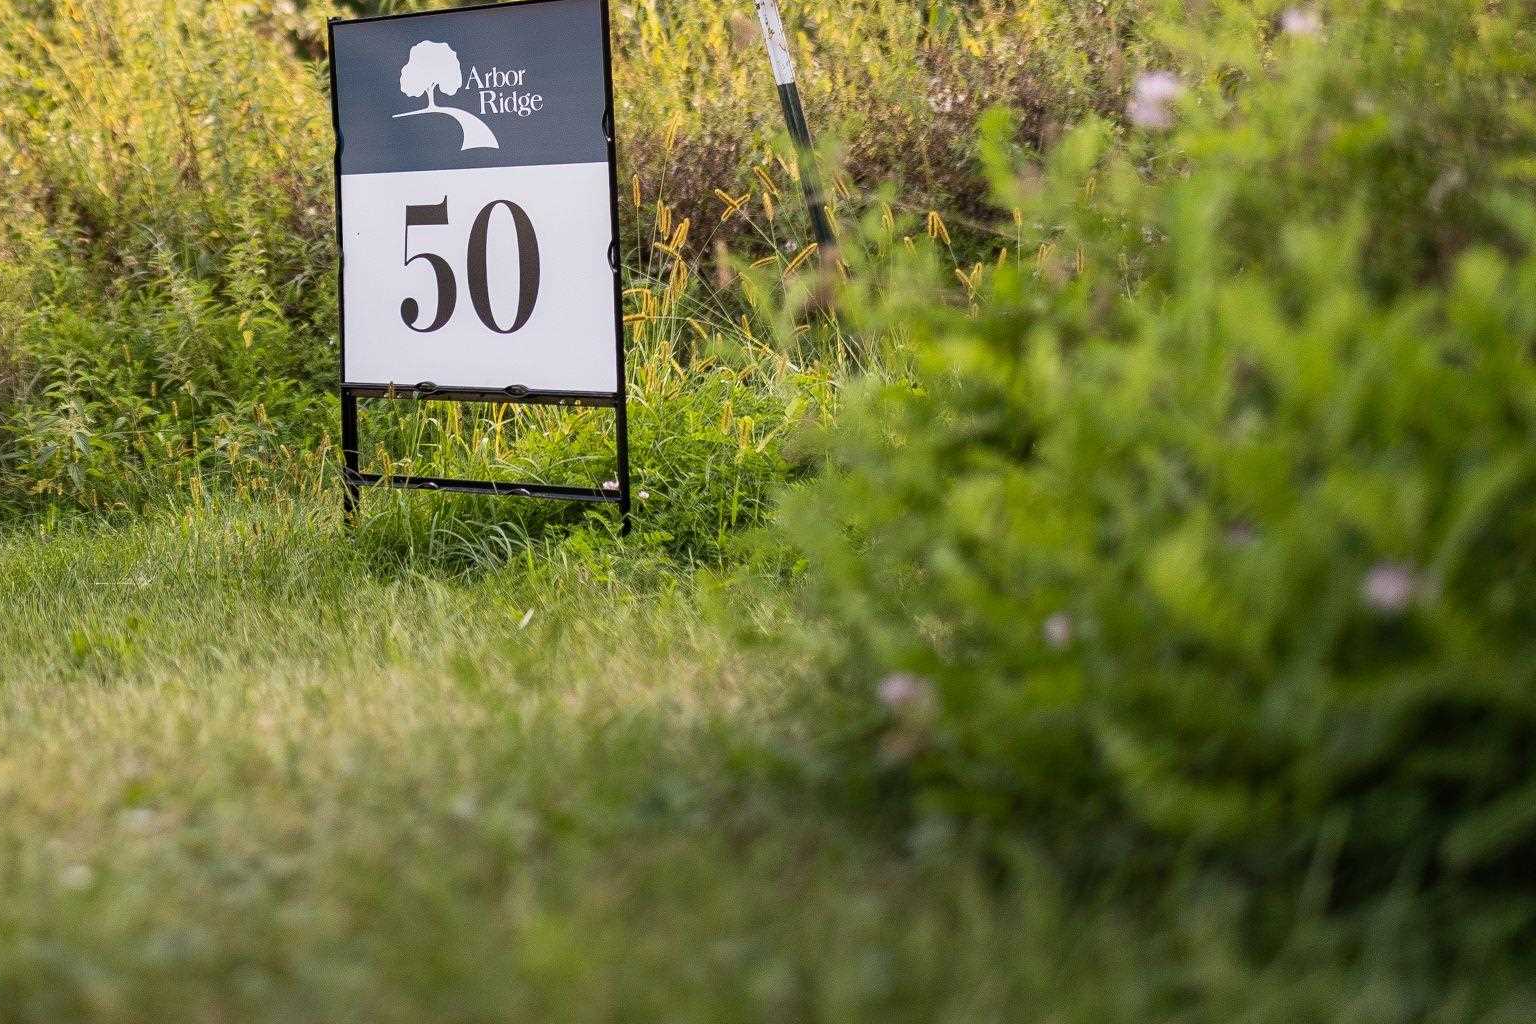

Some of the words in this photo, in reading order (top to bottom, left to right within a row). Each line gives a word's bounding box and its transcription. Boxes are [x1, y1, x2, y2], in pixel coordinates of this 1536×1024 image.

[465, 65, 526, 90] Arbor
[479, 90, 544, 117] Ridge
[400, 194, 540, 334] 50
